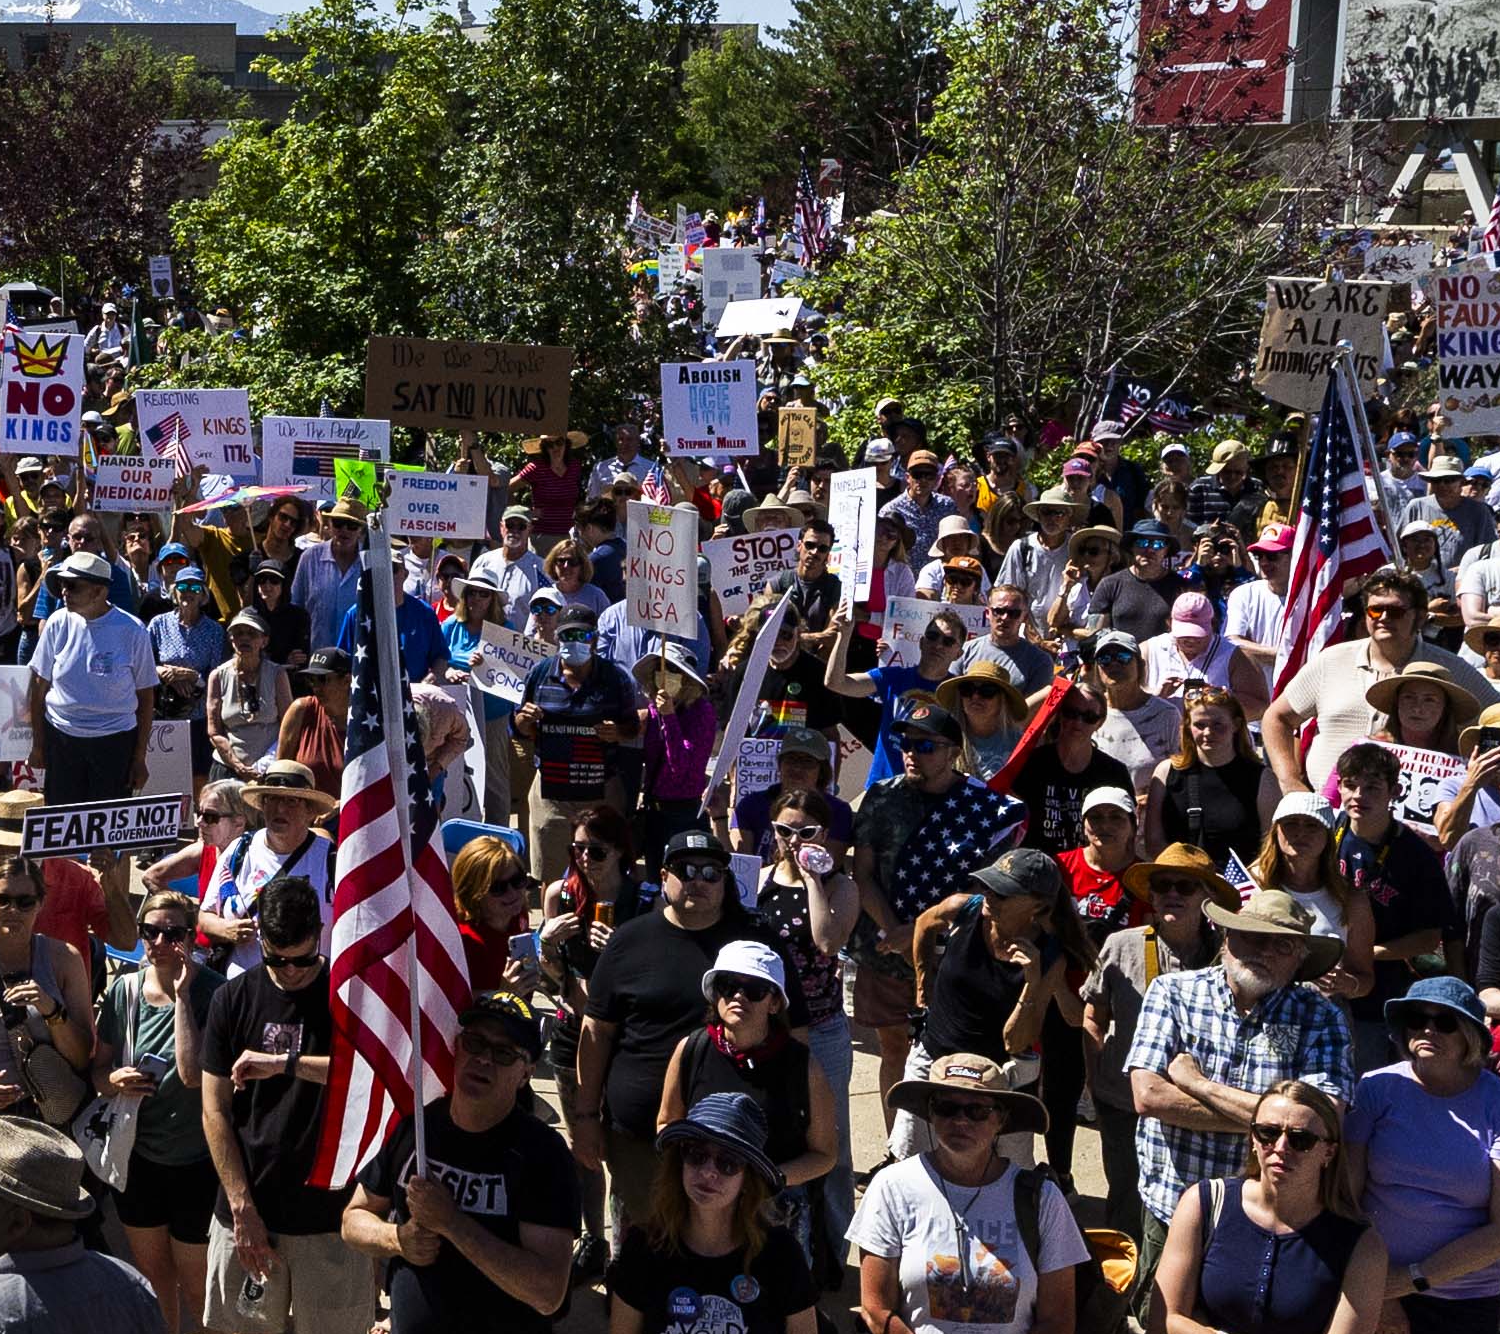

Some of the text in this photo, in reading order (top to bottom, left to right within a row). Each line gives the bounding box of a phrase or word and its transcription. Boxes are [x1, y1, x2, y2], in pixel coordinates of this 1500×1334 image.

[1438, 275, 1481, 302] NO
[1274, 283, 1381, 316] WE ARE
[1285, 318, 1342, 345] ALL
[391, 342, 424, 367] We
[678, 365, 742, 385] ABOLISH
[6, 380, 76, 417] NO
[143, 392, 200, 408] REJECTING
[391, 381, 547, 421] SAY NO KINGS
[688, 383, 731, 414] ICE
[5, 417, 73, 444] KINGS
[202, 418, 247, 436] KINGS
[275, 422, 369, 443] We People
[707, 425, 715, 436] &
[676, 436, 747, 450] STEPHEN MILLER
[100, 456, 176, 469] HANDS OFF!
[223, 444, 251, 464] 1776
[120, 469, 153, 484] OUR
[402, 477, 458, 492] FREEDOM
[95, 485, 173, 502] MEDICAID!
[407, 502, 440, 515] OVER
[399, 518, 457, 533] FASCISM
[637, 528, 674, 556] NO
[732, 533, 795, 564] STOP
[630, 556, 686, 586] KINGS
[727, 560, 795, 578] THE STEAL
[750, 572, 765, 583] OF
[647, 585, 666, 601] IN
[723, 585, 744, 599] OUR
[637, 599, 679, 624] USA
[511, 633, 548, 658] FREE
[1412, 752, 1463, 768] TRUMP
[738, 769, 773, 783] Steel
[23, 803, 180, 852] FEAR IS NOT
[106, 823, 178, 843] GOVERNANCE
[672, 1304, 696, 1314] TRUMP
